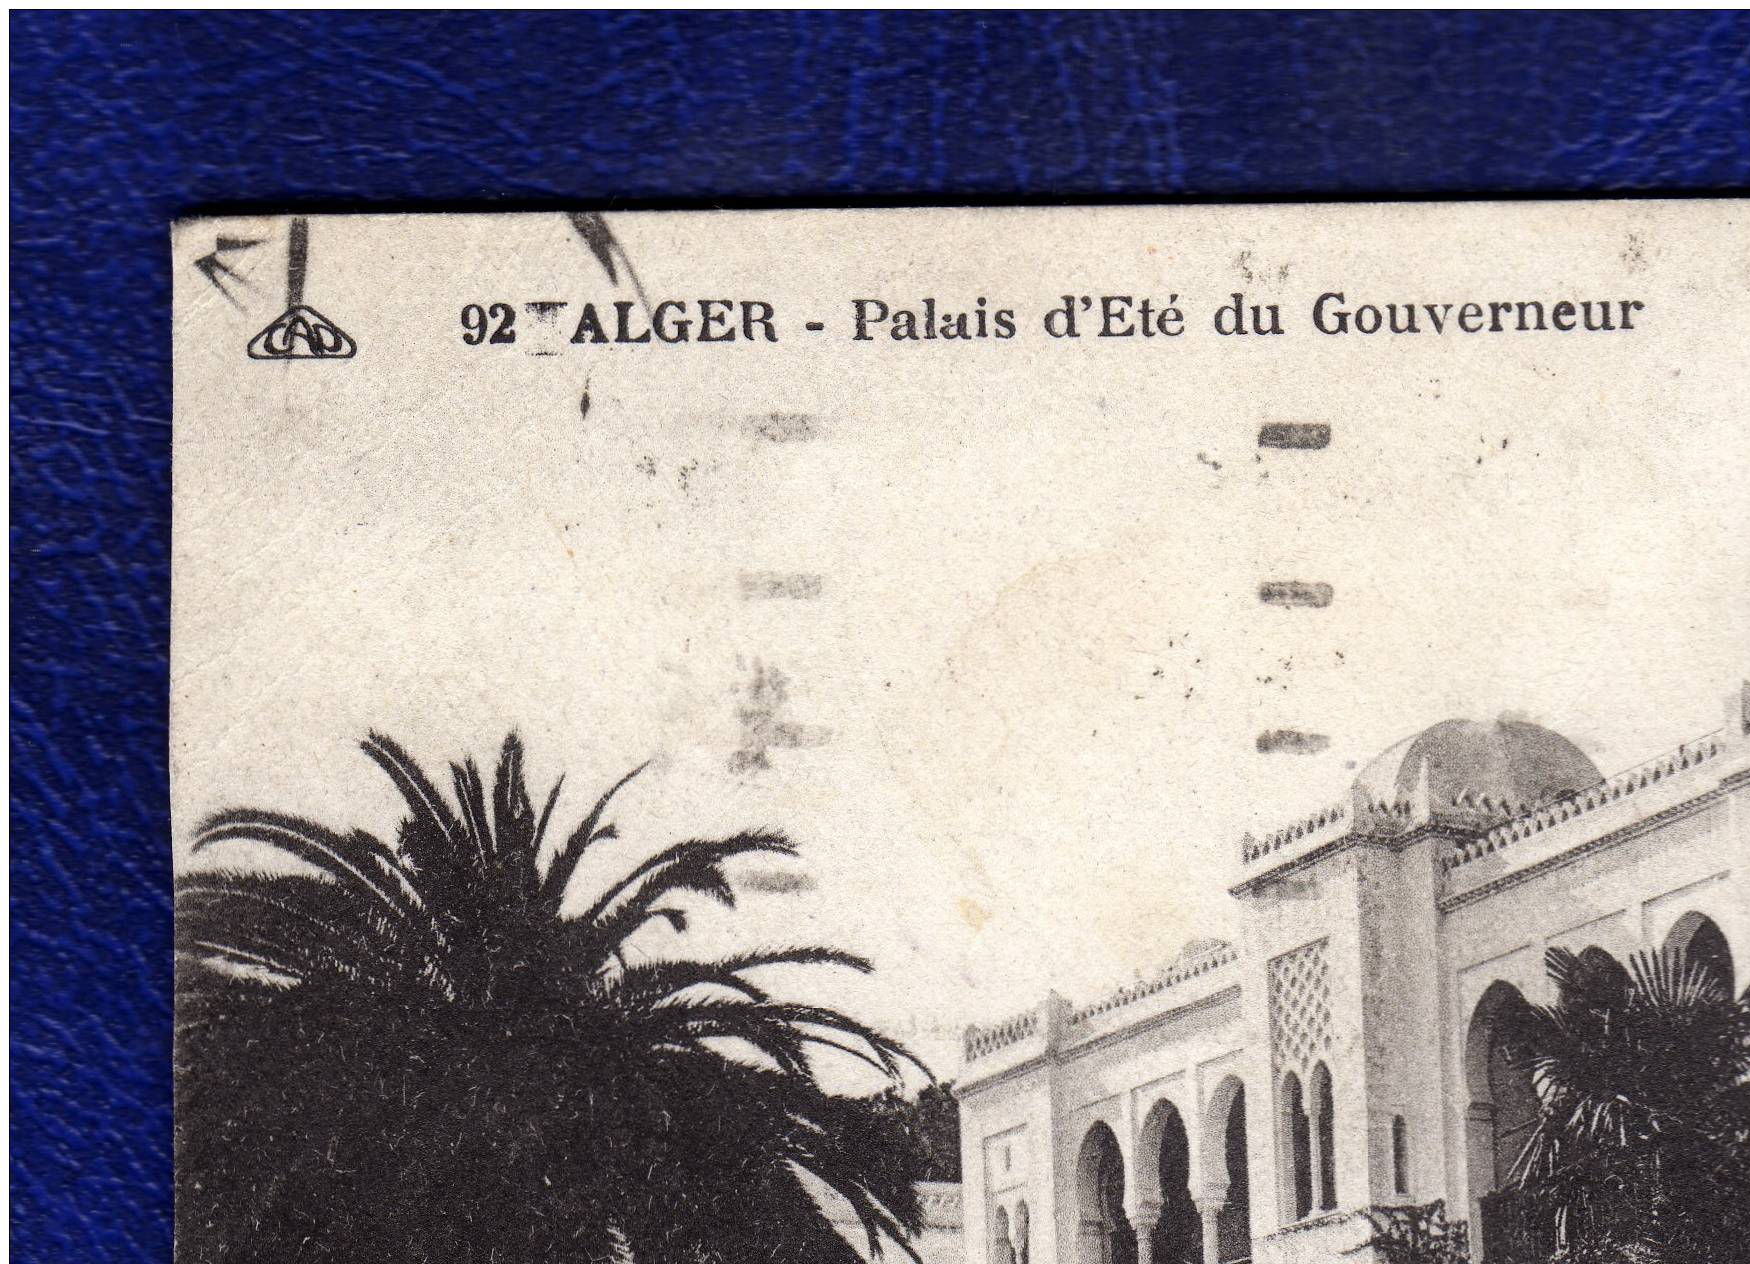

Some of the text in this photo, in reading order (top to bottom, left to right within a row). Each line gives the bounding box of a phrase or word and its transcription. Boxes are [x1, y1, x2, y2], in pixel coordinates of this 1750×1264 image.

[461, 302, 516, 346] 92
[570, 299, 778, 344] ALGER
[852, 298, 1016, 341] Palais
[1044, 293, 1185, 338] d'Eté
[1215, 293, 1285, 336] du
[1313, 293, 1645, 335] Gouverneur
